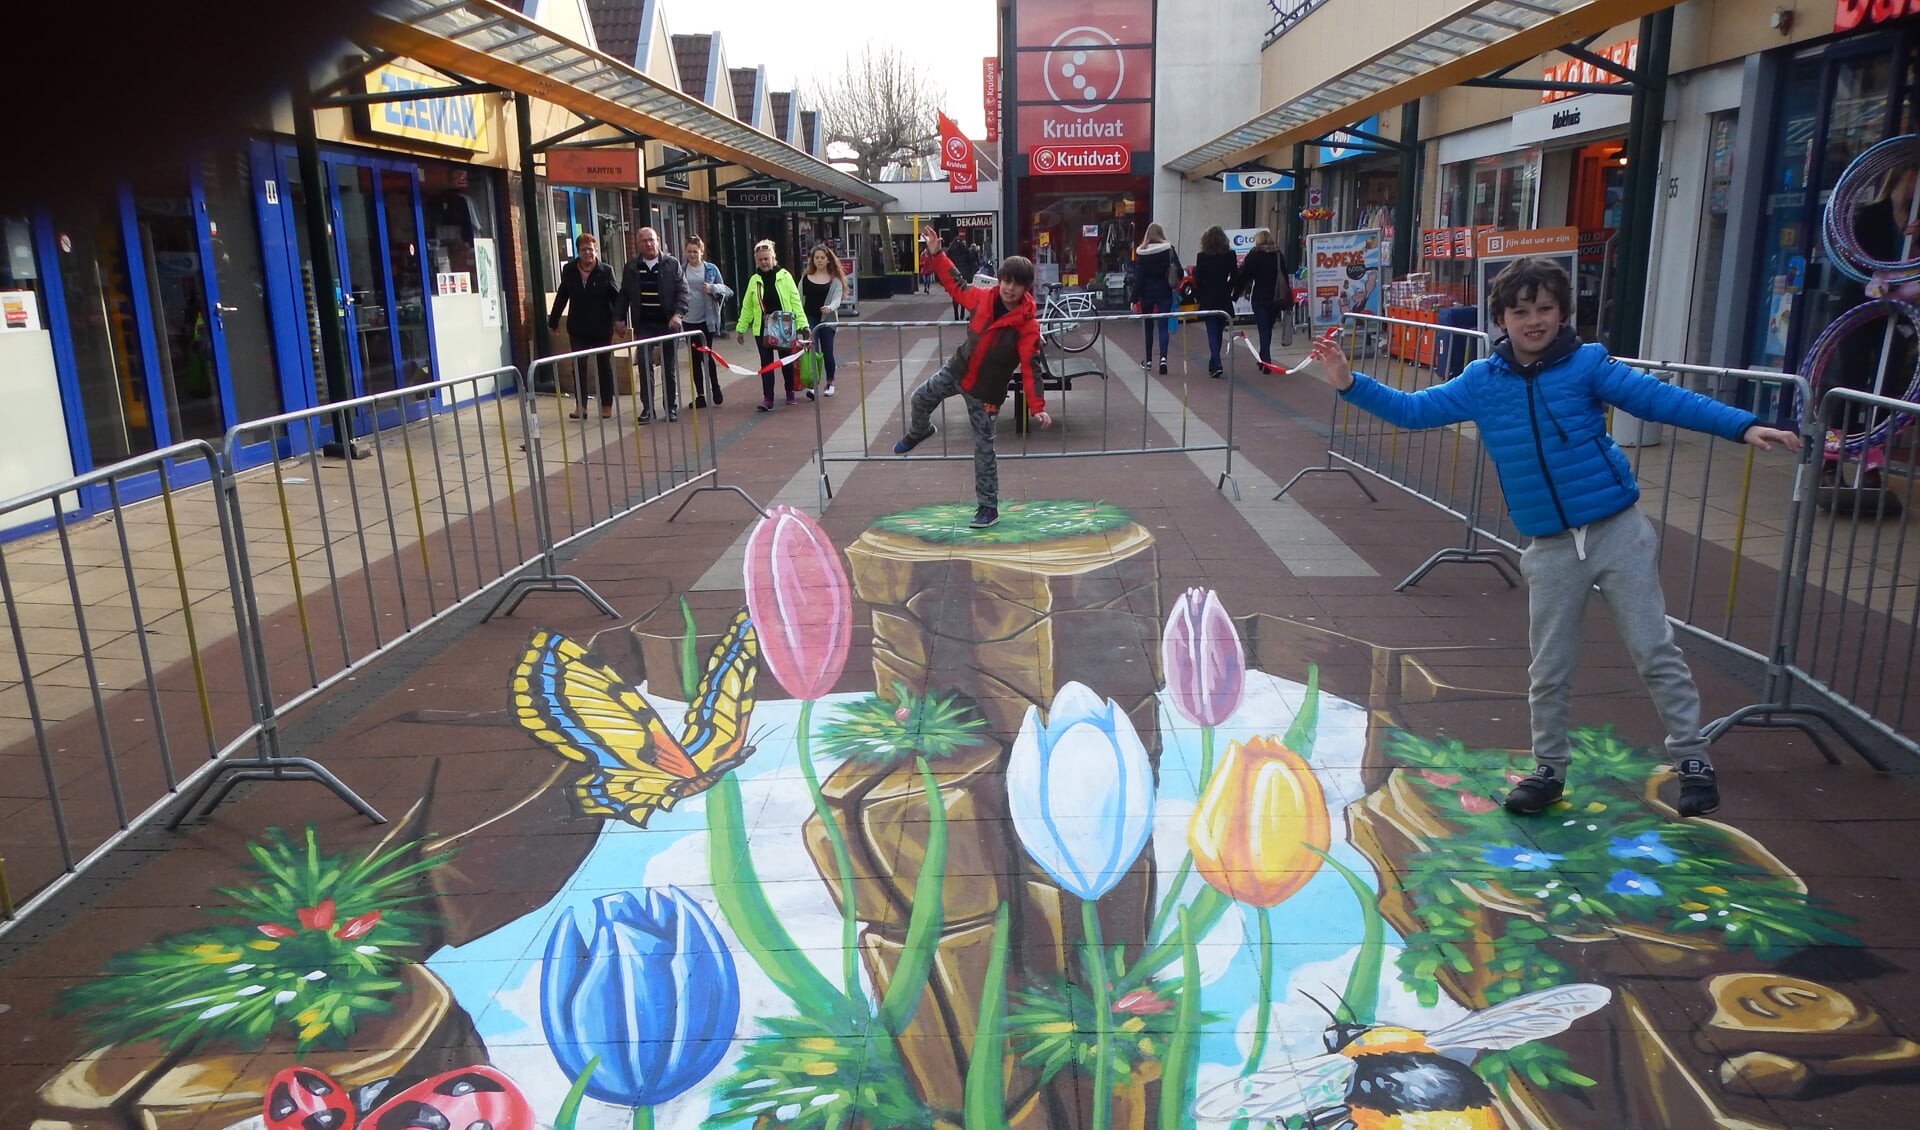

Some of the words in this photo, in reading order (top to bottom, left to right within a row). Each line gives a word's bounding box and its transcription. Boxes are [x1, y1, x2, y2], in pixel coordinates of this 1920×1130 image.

[986, 62, 994, 96] Kruidvat
[380, 71, 476, 140] ZEEMAN
[1043, 118, 1123, 138] Kruidvat
[946, 161, 967, 169] Kruidvat
[1057, 151, 1121, 167] Kruidvat
[740, 192, 776, 202] norah
[1233, 234, 1255, 246] eto
[1505, 238, 1519, 248] fijn
[1556, 235, 1570, 244] zijn
[1316, 251, 1364, 269] POPEYE
